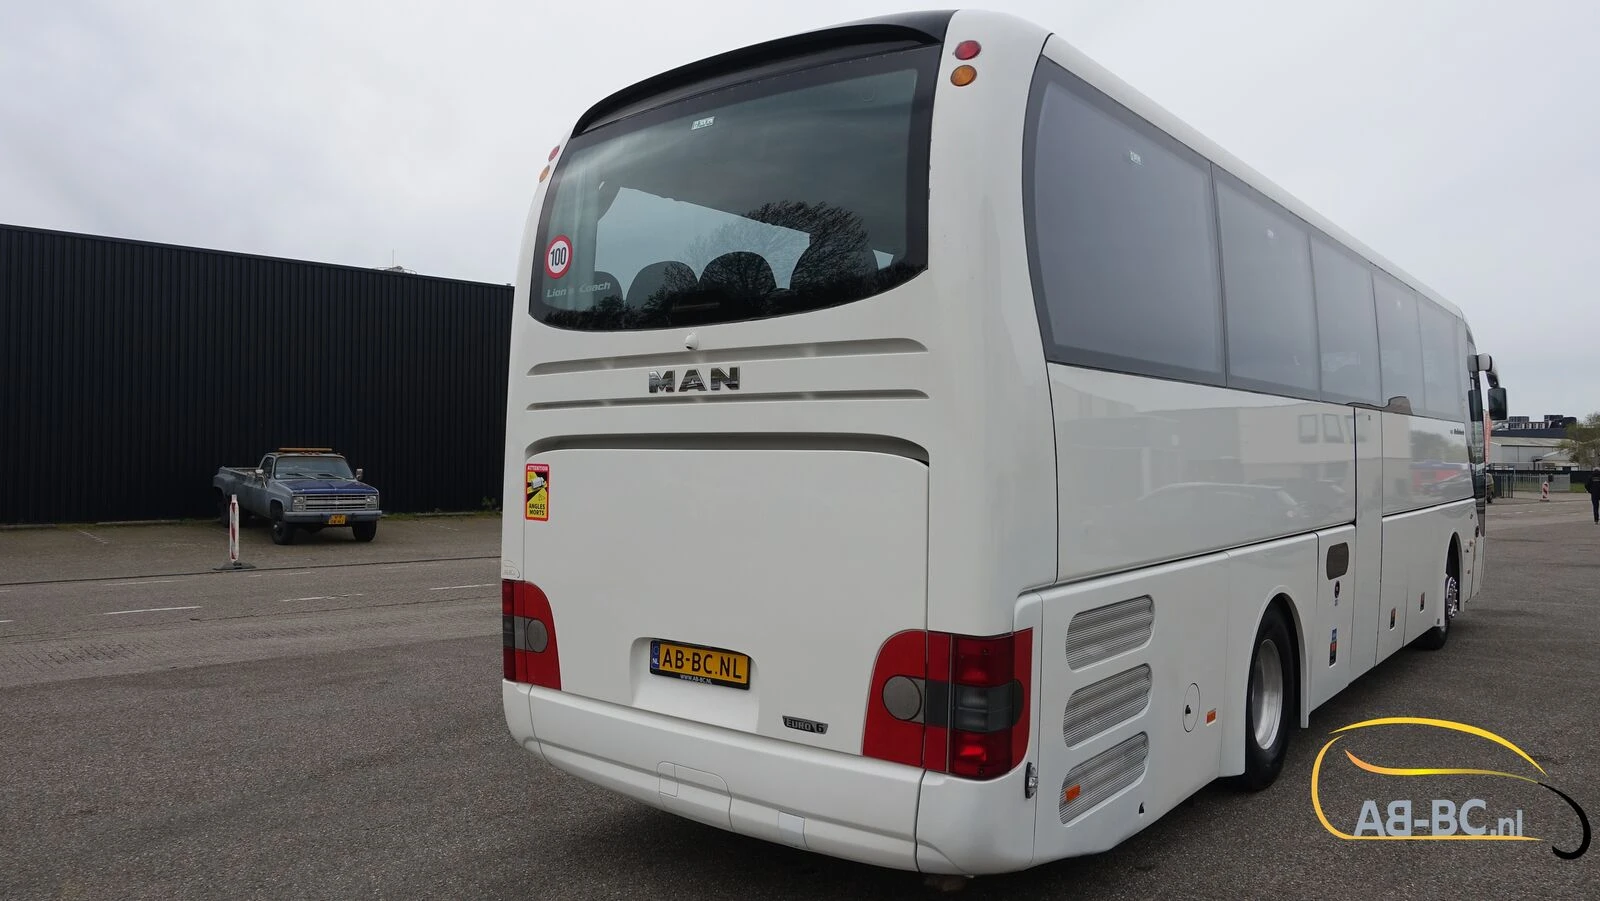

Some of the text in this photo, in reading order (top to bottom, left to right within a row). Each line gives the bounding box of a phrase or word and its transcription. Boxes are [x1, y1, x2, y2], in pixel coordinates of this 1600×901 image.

[550, 246, 567, 267] 100
[648, 367, 740, 393] MAN
[652, 657, 659, 665] NL
[662, 648, 742, 680] AB-BC.NL
[786, 718, 825, 733] EURO 6
